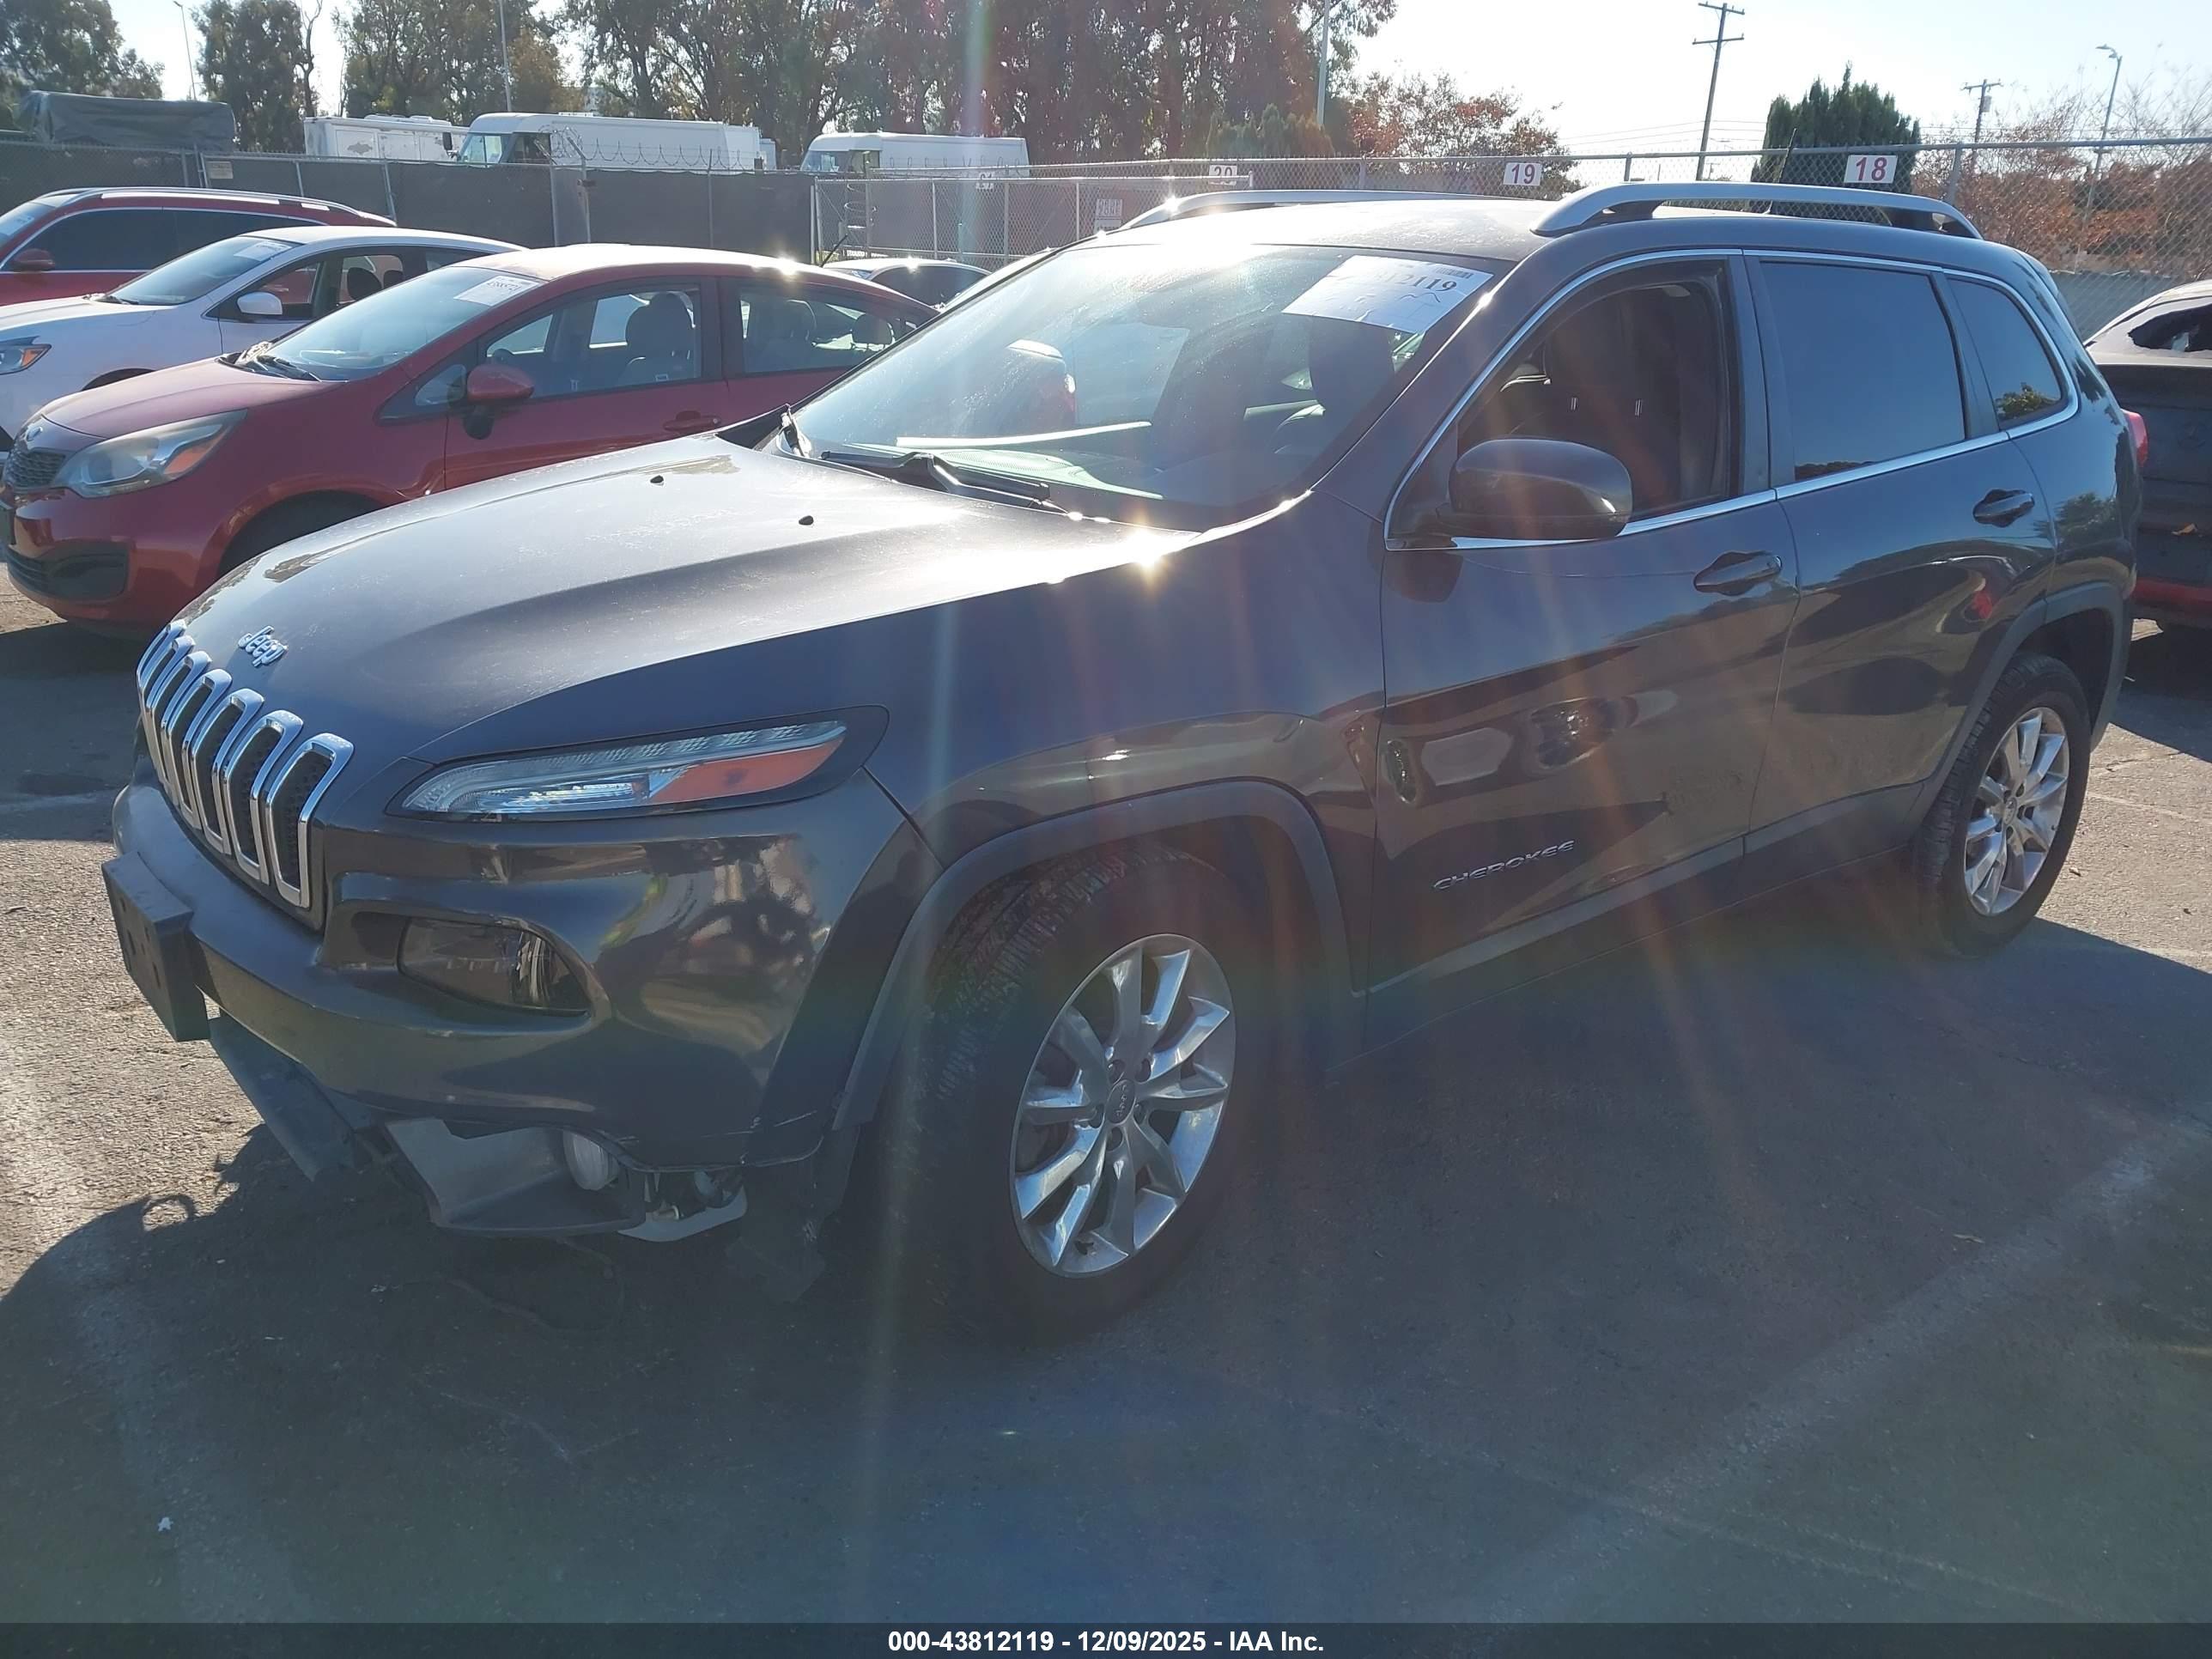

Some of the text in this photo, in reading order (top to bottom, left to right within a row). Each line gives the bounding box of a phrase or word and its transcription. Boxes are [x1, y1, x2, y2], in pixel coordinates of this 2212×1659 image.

[1511, 163, 1535, 184] 19
[1856, 156, 1887, 181] 18
[238, 625, 288, 667] Jeep
[1432, 840, 1575, 890] CHEROKEE
